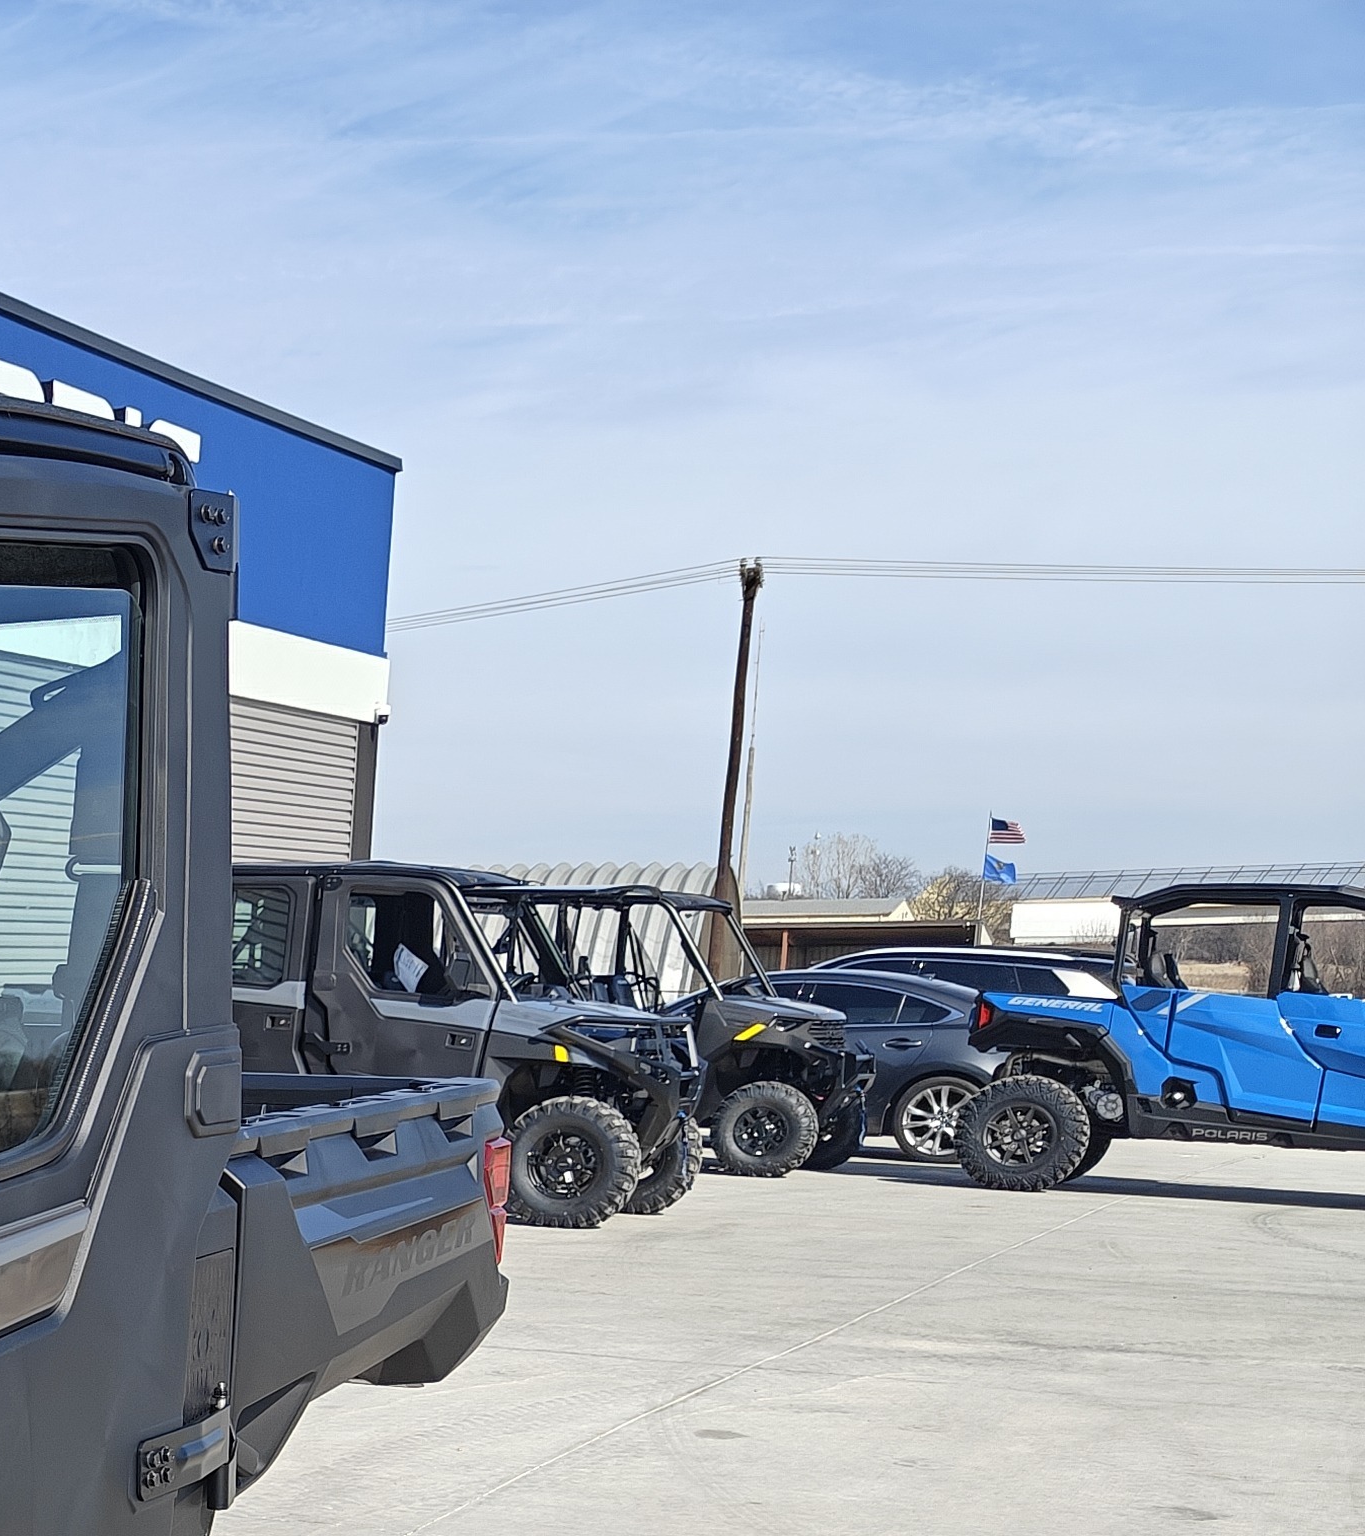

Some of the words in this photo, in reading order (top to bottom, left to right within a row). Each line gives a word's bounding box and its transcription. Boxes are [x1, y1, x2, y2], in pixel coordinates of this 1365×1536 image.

[1007, 996, 1104, 1013] GENERAL
[1192, 1128, 1268, 1141] POLARIS
[340, 1211, 476, 1297] RANGER
